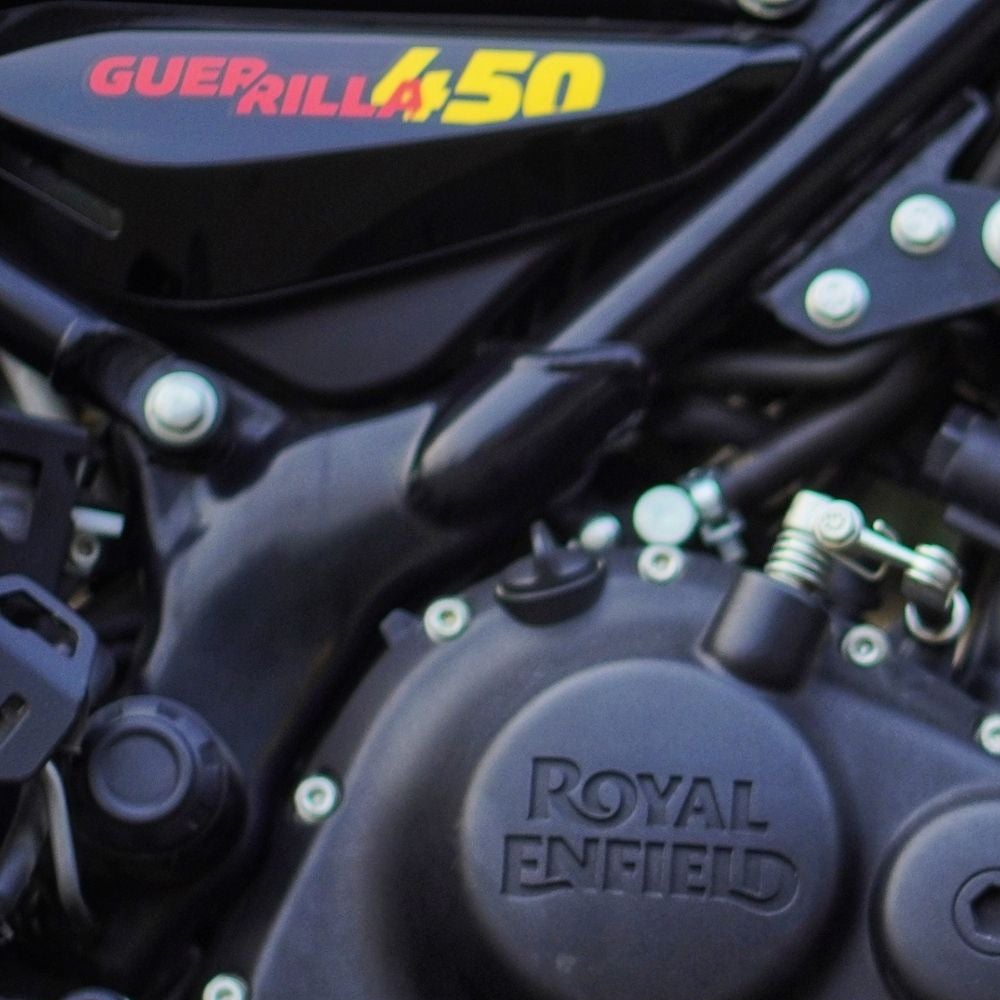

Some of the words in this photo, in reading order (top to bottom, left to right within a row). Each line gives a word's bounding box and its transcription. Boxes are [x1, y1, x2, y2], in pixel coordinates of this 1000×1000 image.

[88, 55, 423, 116] GUERRILLA
[371, 47, 604, 125] 450
[527, 755, 769, 832] ROYAL
[501, 833, 799, 916] ENFIELD
